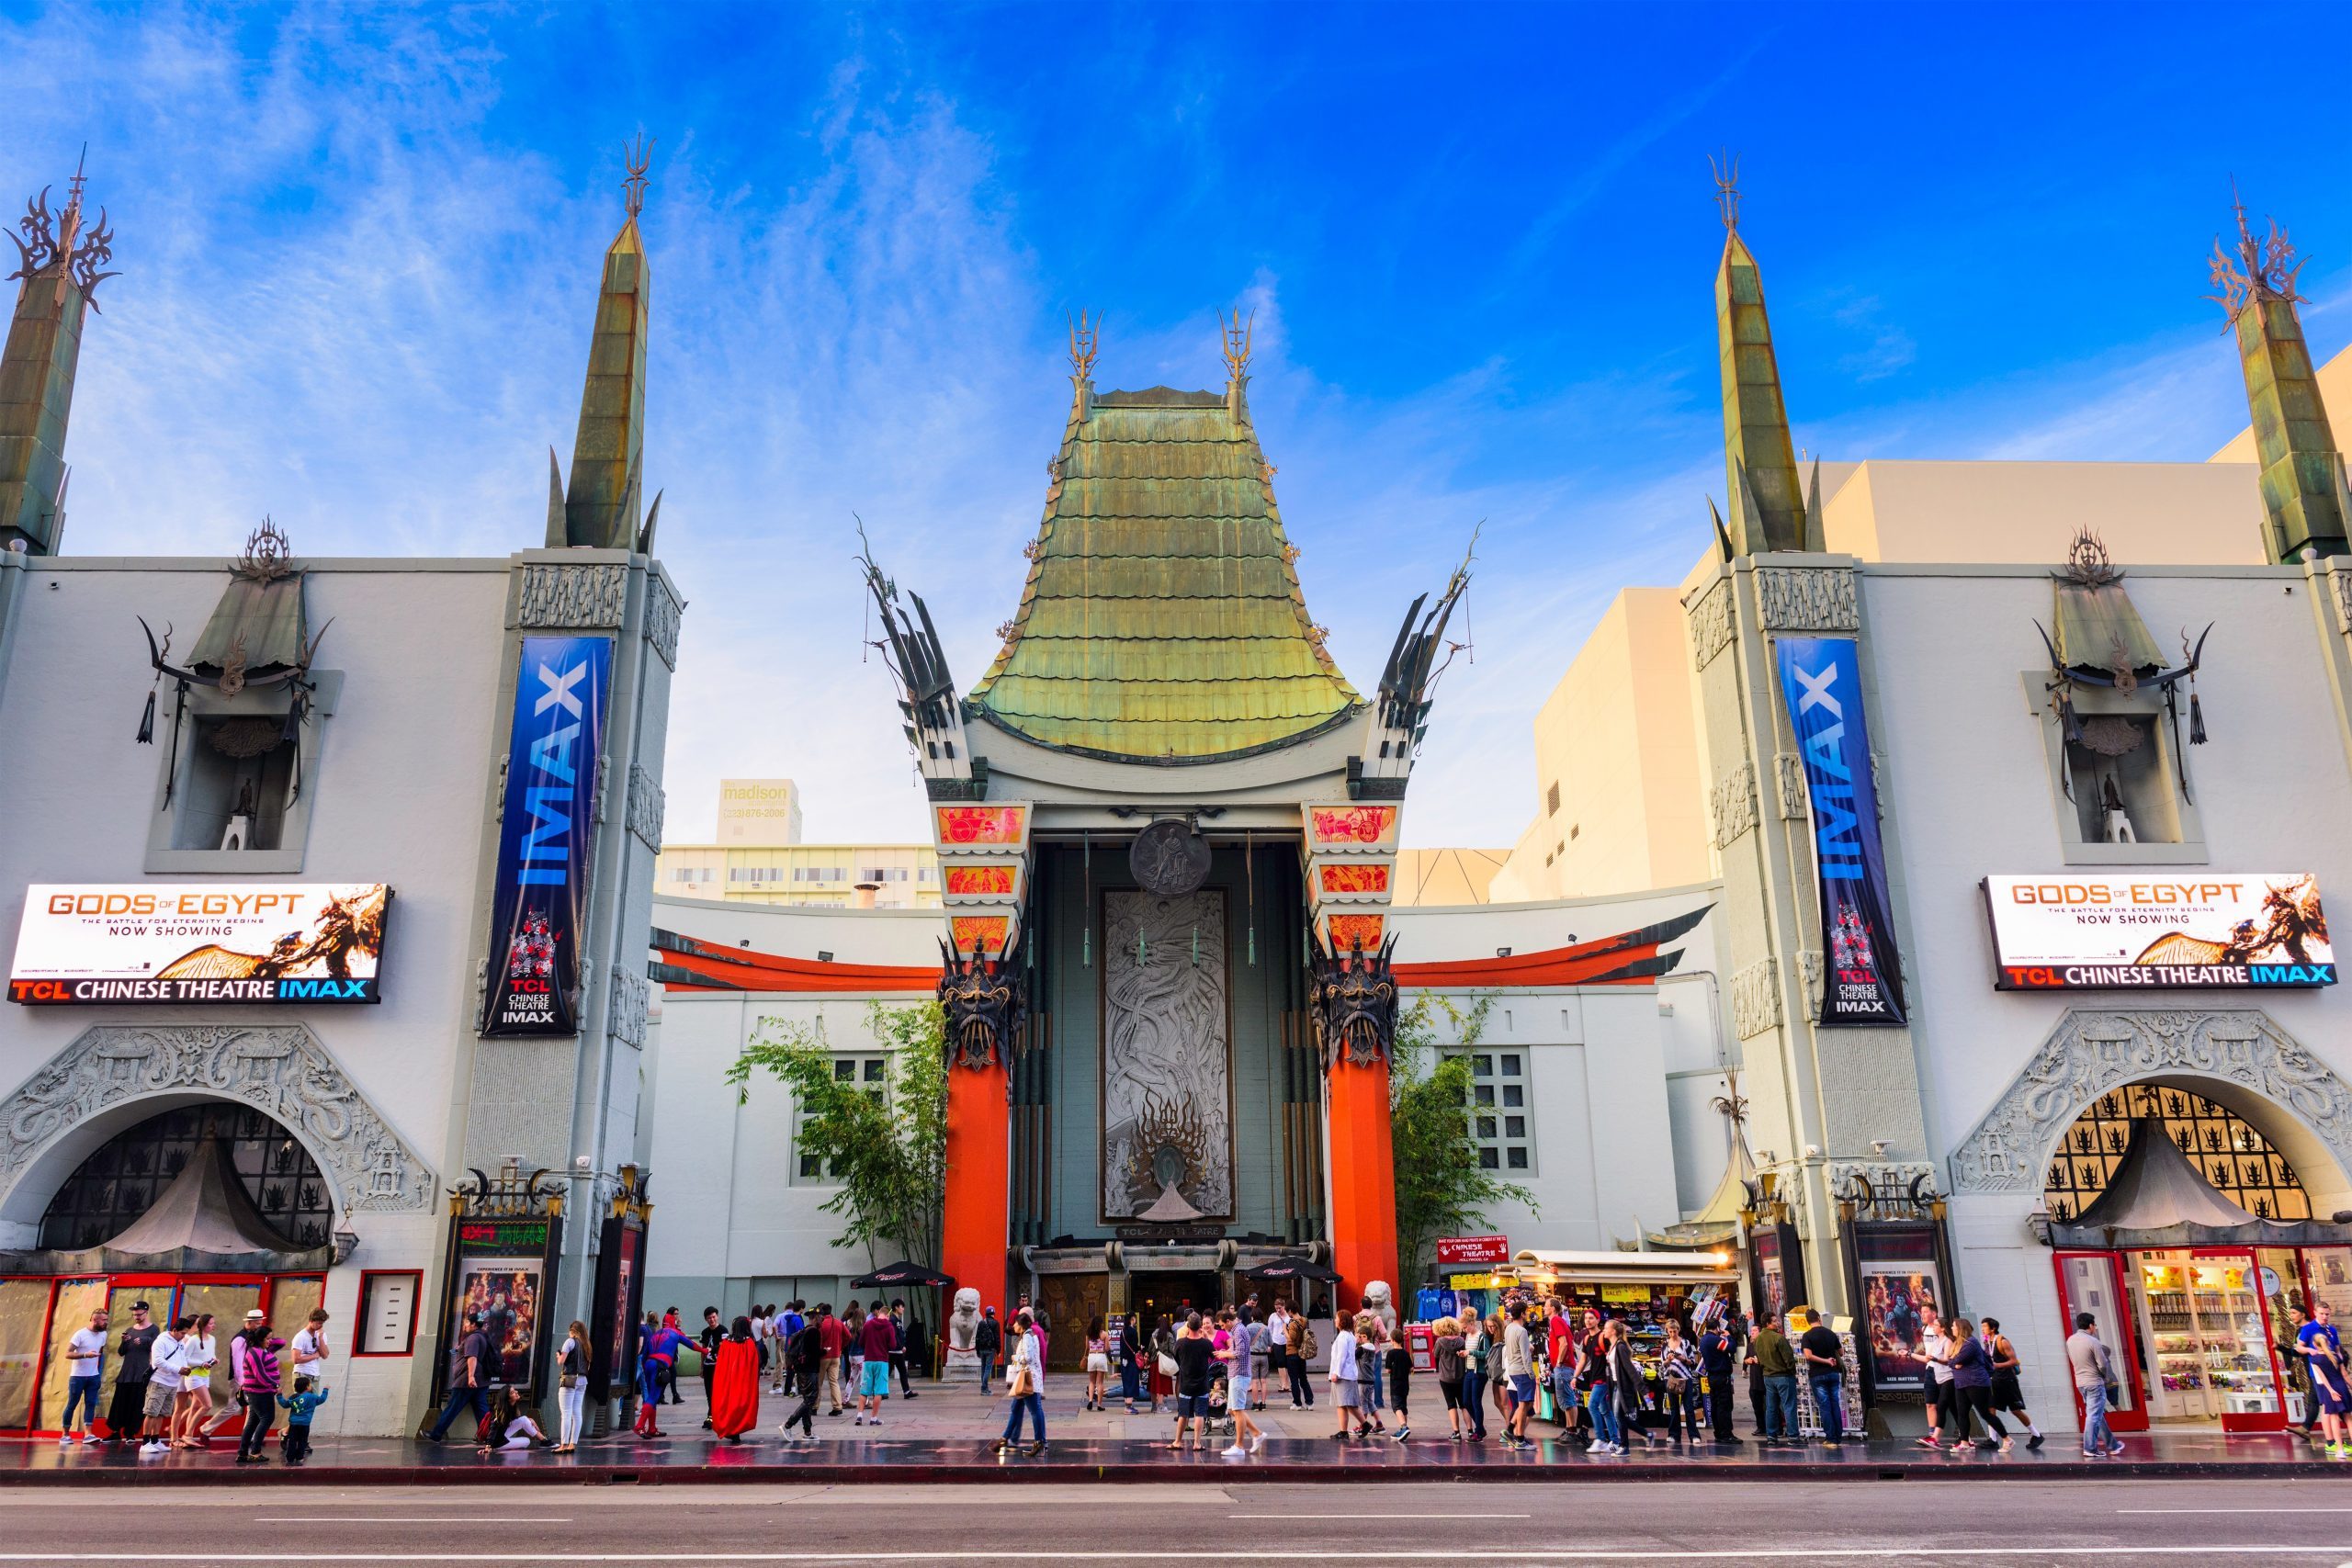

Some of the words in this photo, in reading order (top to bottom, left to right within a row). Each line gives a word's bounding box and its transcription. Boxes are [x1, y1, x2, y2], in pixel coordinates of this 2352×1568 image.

[517, 660, 587, 886] IMAX
[1793, 660, 1863, 880] IMAX
[724, 784, 786, 799] madison
[2012, 885, 2111, 904] GODS
[2130, 884, 2244, 904] EGYPT
[48, 894, 157, 915] GODS
[159, 900, 176, 908] OF
[177, 894, 305, 915] EGYPT
[2076, 915, 2111, 924] NOW
[2119, 915, 2190, 924] SHOWING
[109, 926, 148, 936] NOW
[155, 926, 232, 936] SHOWING
[1838, 969, 1878, 983] TCL
[2007, 967, 2064, 986] TCL
[2065, 966, 2154, 985] CHINESE
[2155, 965, 2249, 984] THEATRE
[2251, 965, 2333, 983] IMAX
[12, 981, 71, 999] TCL
[75, 980, 171, 999] CHINESE
[176, 980, 275, 998] THEATRE
[279, 980, 368, 998] IMAX
[510, 979, 551, 992] TCL
[1838, 984, 1877, 992] CHINESE
[508, 994, 550, 1002] CHINESE
[1839, 992, 1879, 1000] THEATRE
[508, 1001, 549, 1010] THEATRE
[1836, 1001, 1886, 1012] IMAX
[502, 1011, 555, 1023] IMAX
